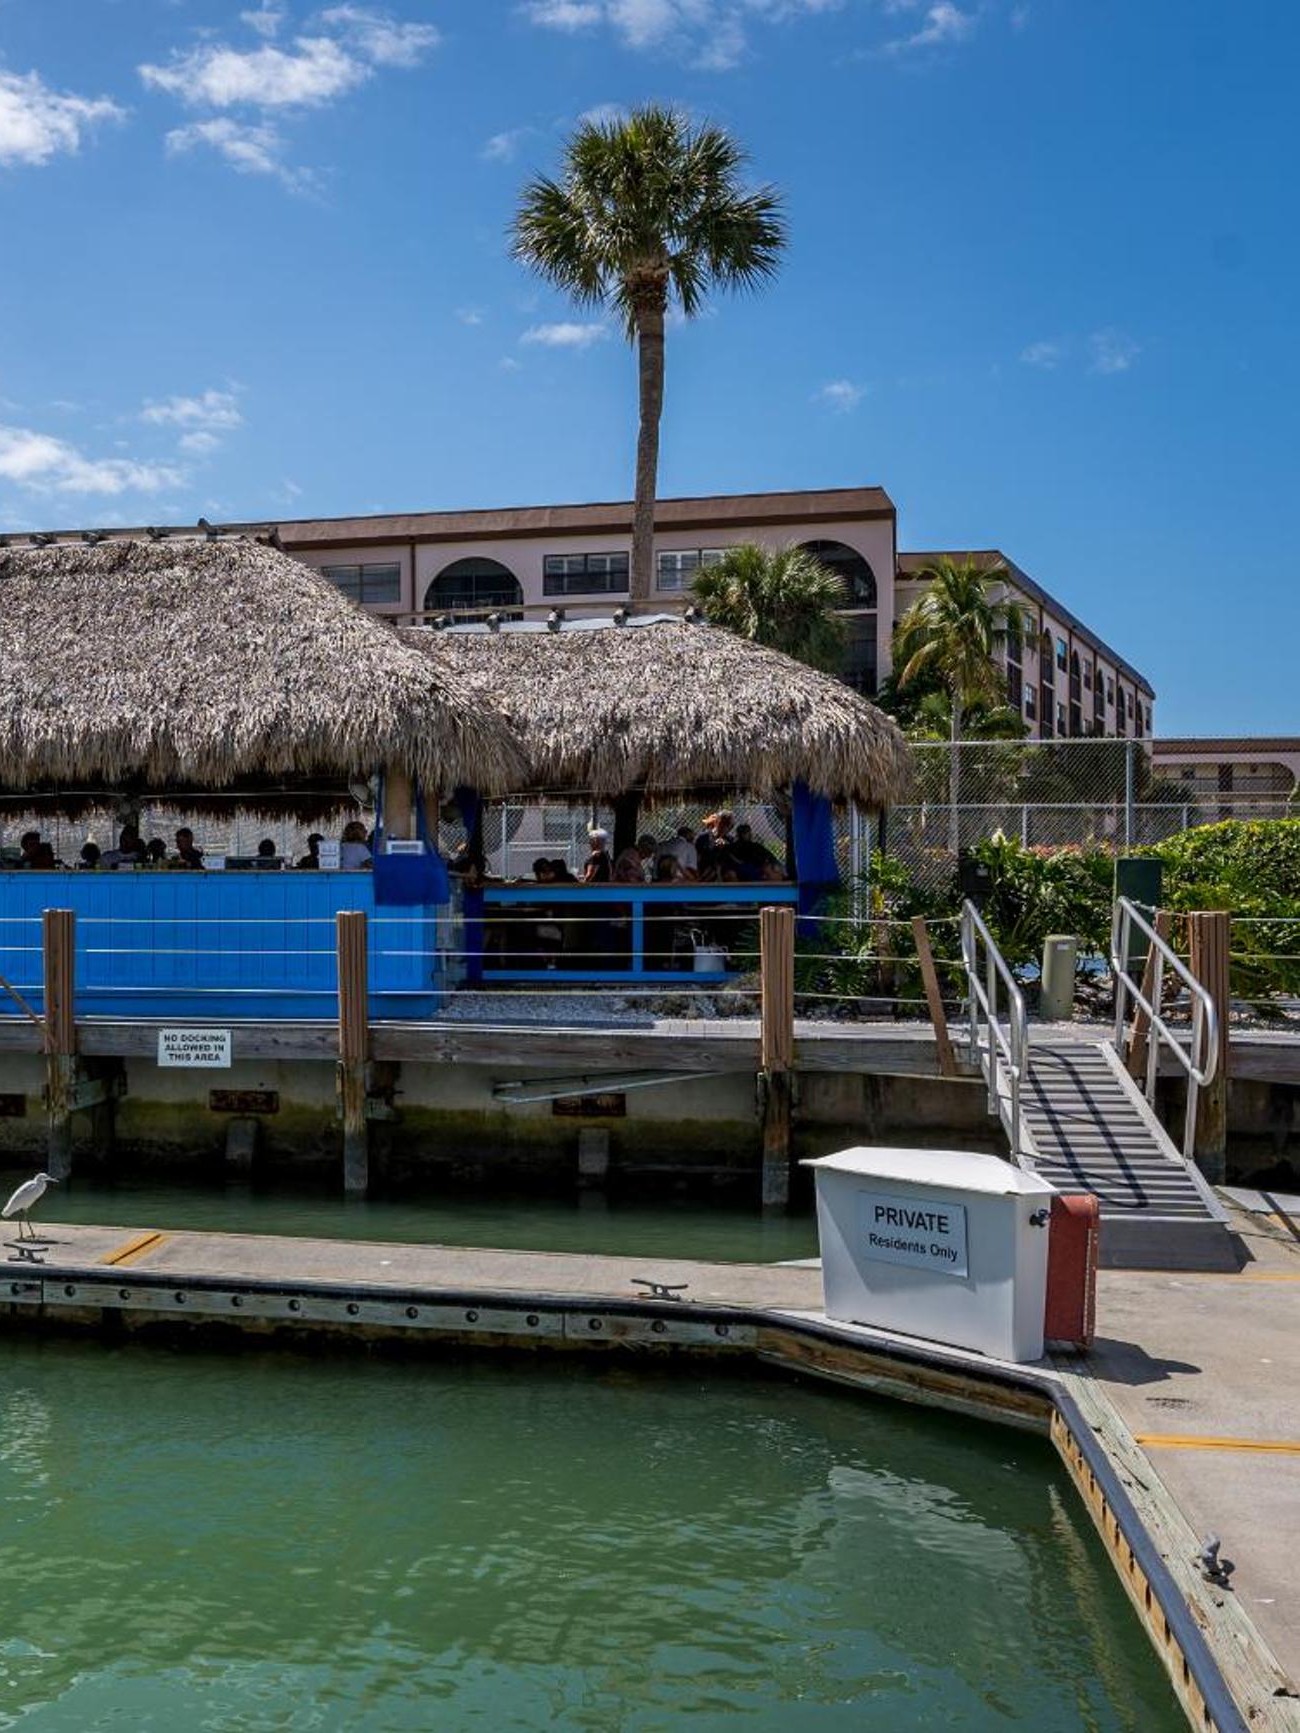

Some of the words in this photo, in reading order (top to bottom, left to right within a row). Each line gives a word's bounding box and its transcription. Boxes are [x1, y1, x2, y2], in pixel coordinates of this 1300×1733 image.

[164, 1034, 178, 1042] NO
[181, 1034, 226, 1042] DOCKING
[214, 1044, 224, 1052] IN
[169, 1053, 192, 1061] THIS
[194, 1053, 220, 1061] AREA
[874, 1205, 949, 1234] PRIVATE
[868, 1233, 926, 1254] Residents
[930, 1243, 958, 1262] Only
